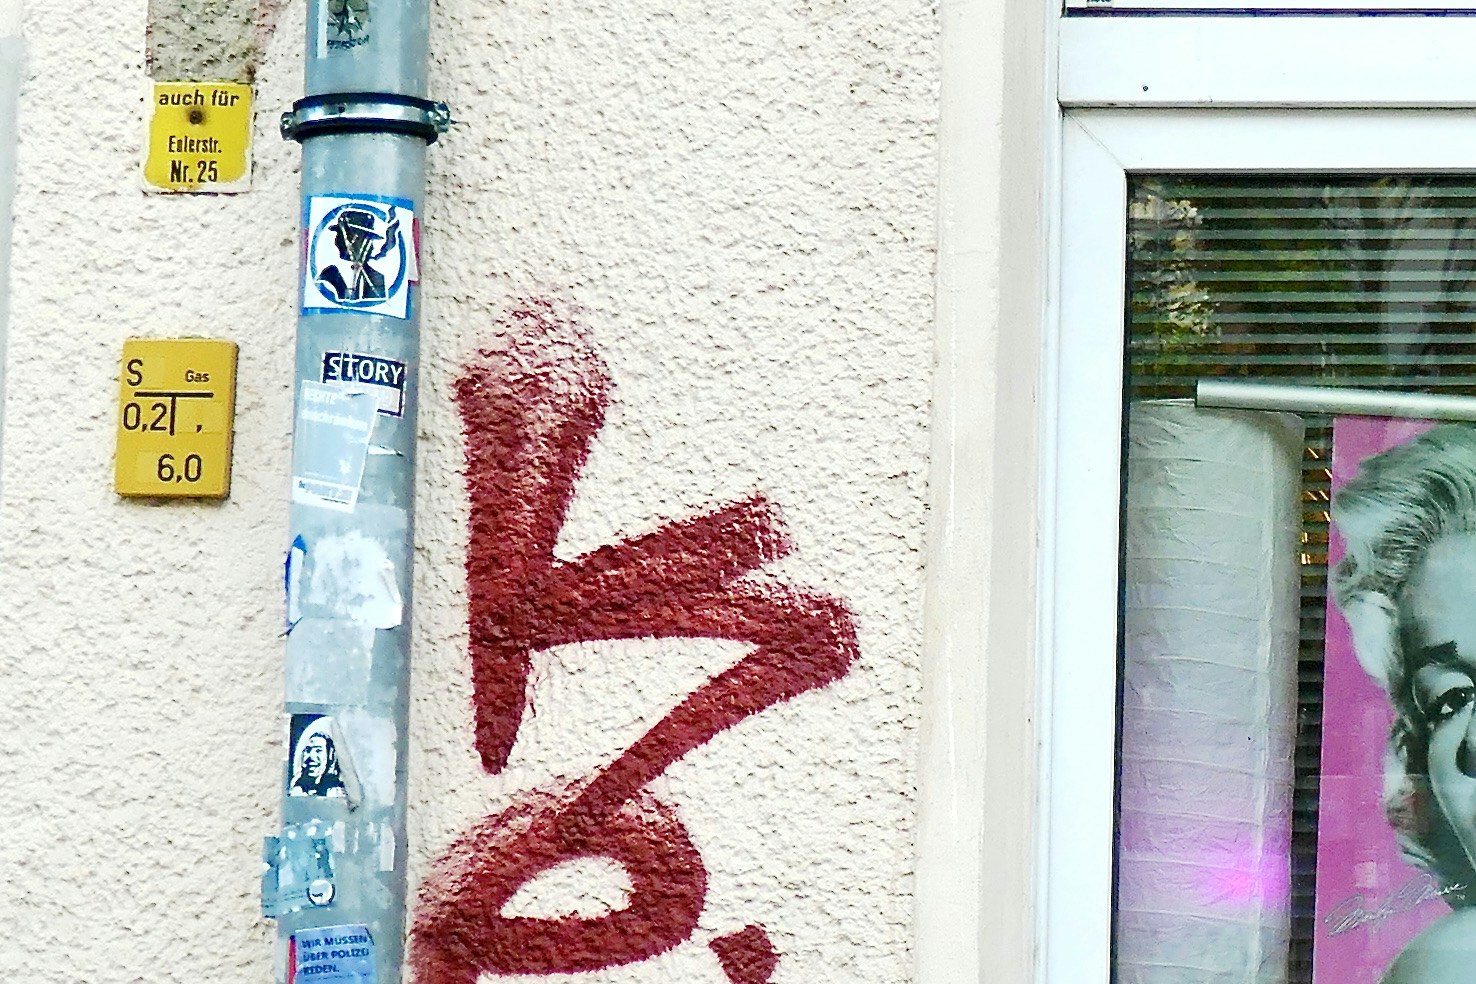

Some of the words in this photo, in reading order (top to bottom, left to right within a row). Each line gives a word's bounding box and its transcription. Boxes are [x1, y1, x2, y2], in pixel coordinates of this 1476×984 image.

[159, 89, 205, 106] auch
[211, 89, 240, 107] für
[170, 160, 193, 183] Nr.
[197, 160, 218, 183] 25
[126, 358, 143, 386] S
[184, 369, 210, 383] Gas
[328, 356, 404, 384] STORY
[157, 453, 202, 483] 6,0
[301, 938, 322, 949] WIR
